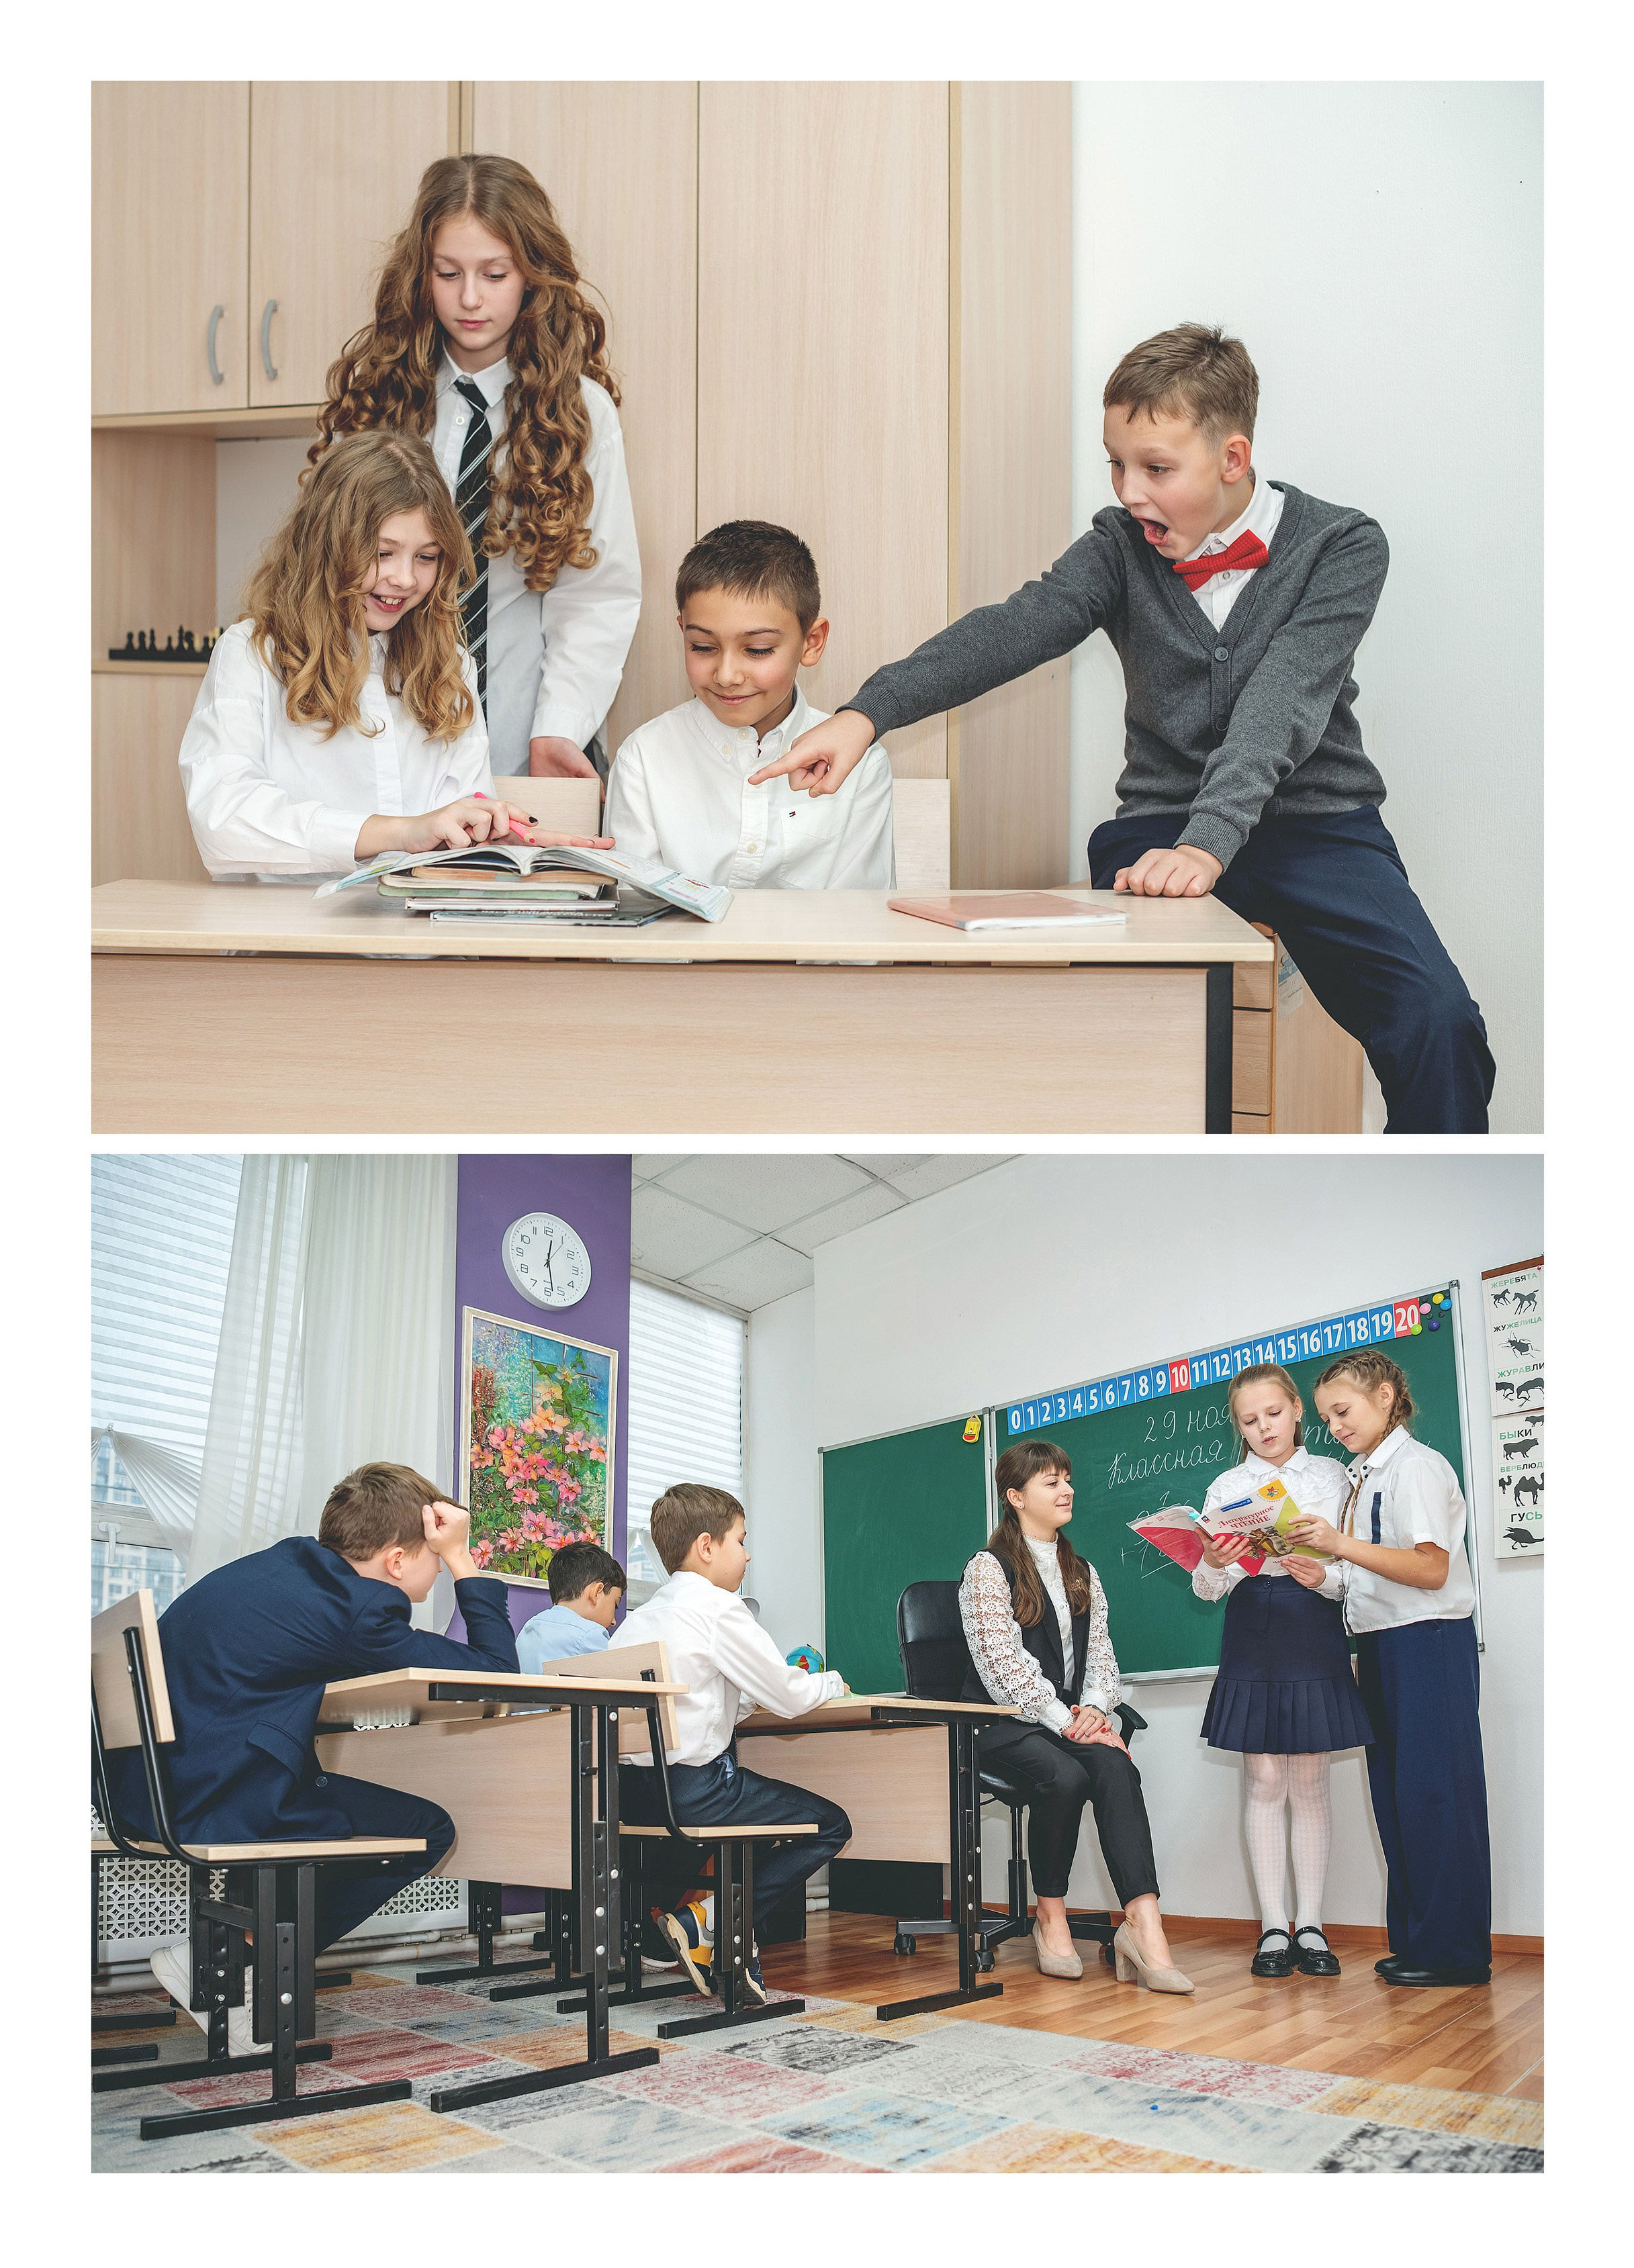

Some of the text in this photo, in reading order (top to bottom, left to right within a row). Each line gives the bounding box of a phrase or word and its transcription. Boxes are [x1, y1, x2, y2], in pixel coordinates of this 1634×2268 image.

[544, 1226, 553, 1237] 12
[520, 1234, 531, 1244] 10
[516, 1247, 524, 1257] 9
[567, 1249, 575, 1260] 2
[520, 1264, 529, 1274] 8
[572, 1266, 579, 1276] 3
[531, 1278, 537, 1287] 7
[567, 1280, 574, 1288] 4
[1490, 1272, 1537, 1289] ЖЕРЕБЯТА
[544, 1287, 551, 1296] 6
[557, 1286, 565, 1296] 5
[1493, 1316, 1542, 1333] ЖУЖЕЛИЦА
[1011, 1305, 1418, 1429] 0 1 2 3 4 5 6 7 8 9 10 11 12 13 14 15 16 17 18 19 20
[1144, 1403, 1234, 1443] 29 ноя
[1500, 1429, 1532, 1440] БЫКИ
[1108, 1440, 1226, 1489] Классная
[1218, 1505, 1275, 1529] Литературное
[1230, 1515, 1271, 1529] ЧТЕНИЕ
[1511, 1511, 1543, 1522] ГУСЬ
